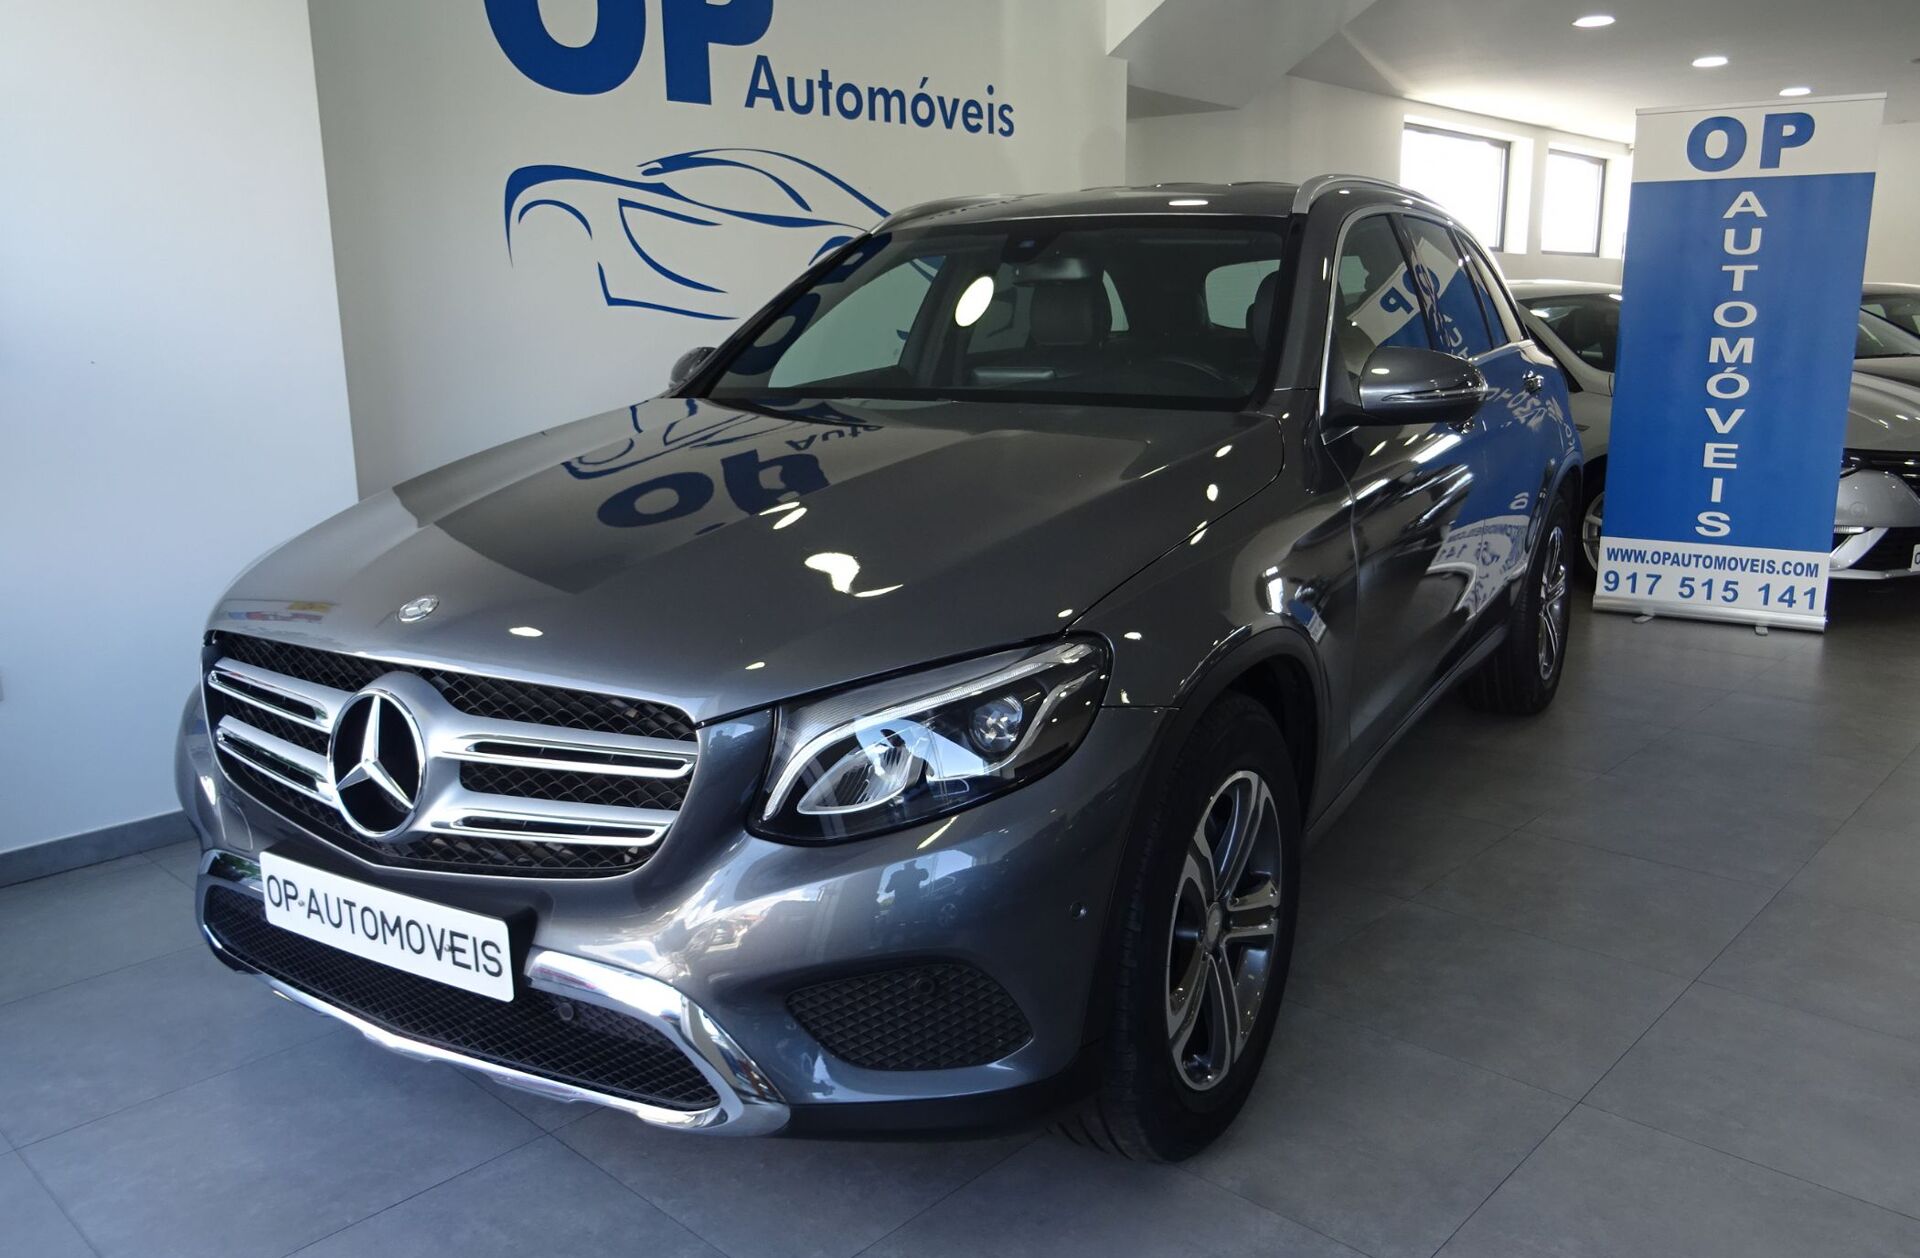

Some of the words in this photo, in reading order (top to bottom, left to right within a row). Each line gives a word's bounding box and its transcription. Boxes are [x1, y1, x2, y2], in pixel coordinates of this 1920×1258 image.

[484, 0, 774, 105] OP
[744, 54, 1015, 137] Automóveis
[1686, 111, 1815, 172] OP
[1694, 191, 1768, 537] AUTOMÓVEIS
[1603, 570, 1662, 595] 917
[1678, 576, 1739, 603] 515
[1758, 583, 1817, 610] 141
[1606, 547, 1819, 578] WWW.OPAUTOMOVEIS.COM
